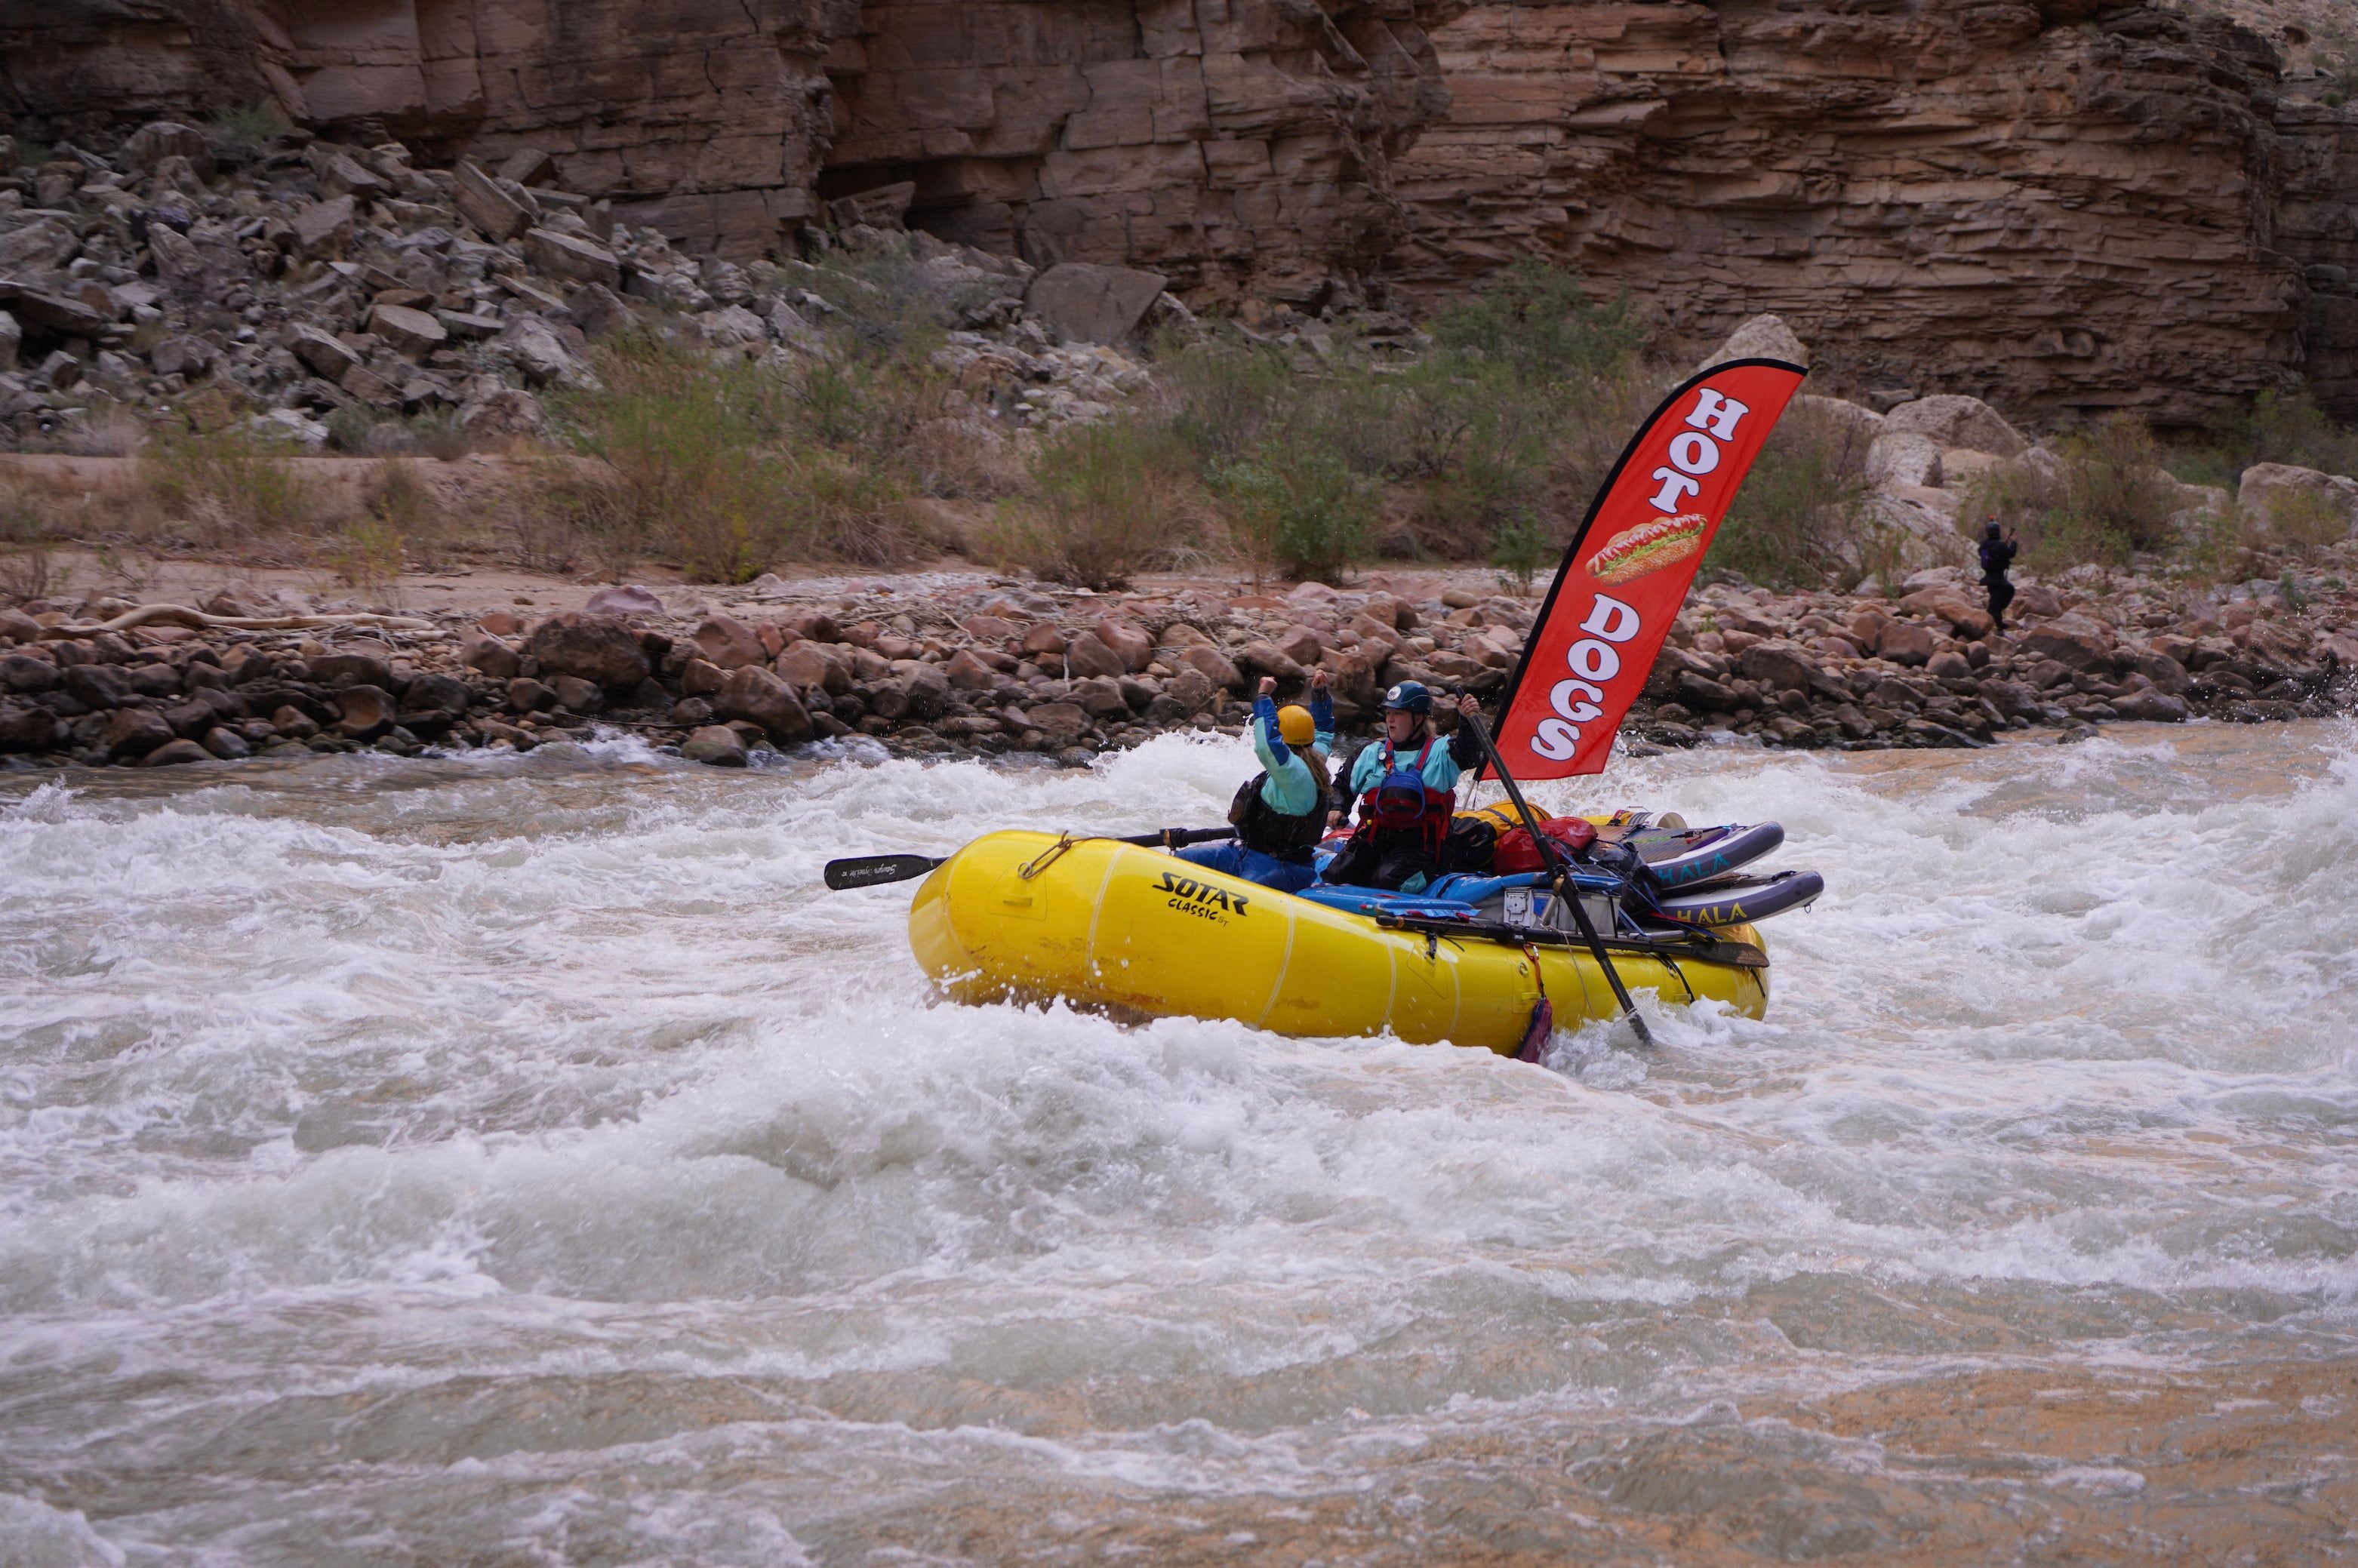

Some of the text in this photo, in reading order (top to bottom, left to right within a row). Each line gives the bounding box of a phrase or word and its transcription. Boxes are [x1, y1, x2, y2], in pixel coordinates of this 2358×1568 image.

[1531, 387, 1750, 761] HOT DOGS
[1658, 852, 1731, 884] HALA
[1152, 872, 1250, 917] SOTAR
[1168, 898, 1218, 921] CLASSIC
[1677, 902, 1748, 925] HALA
